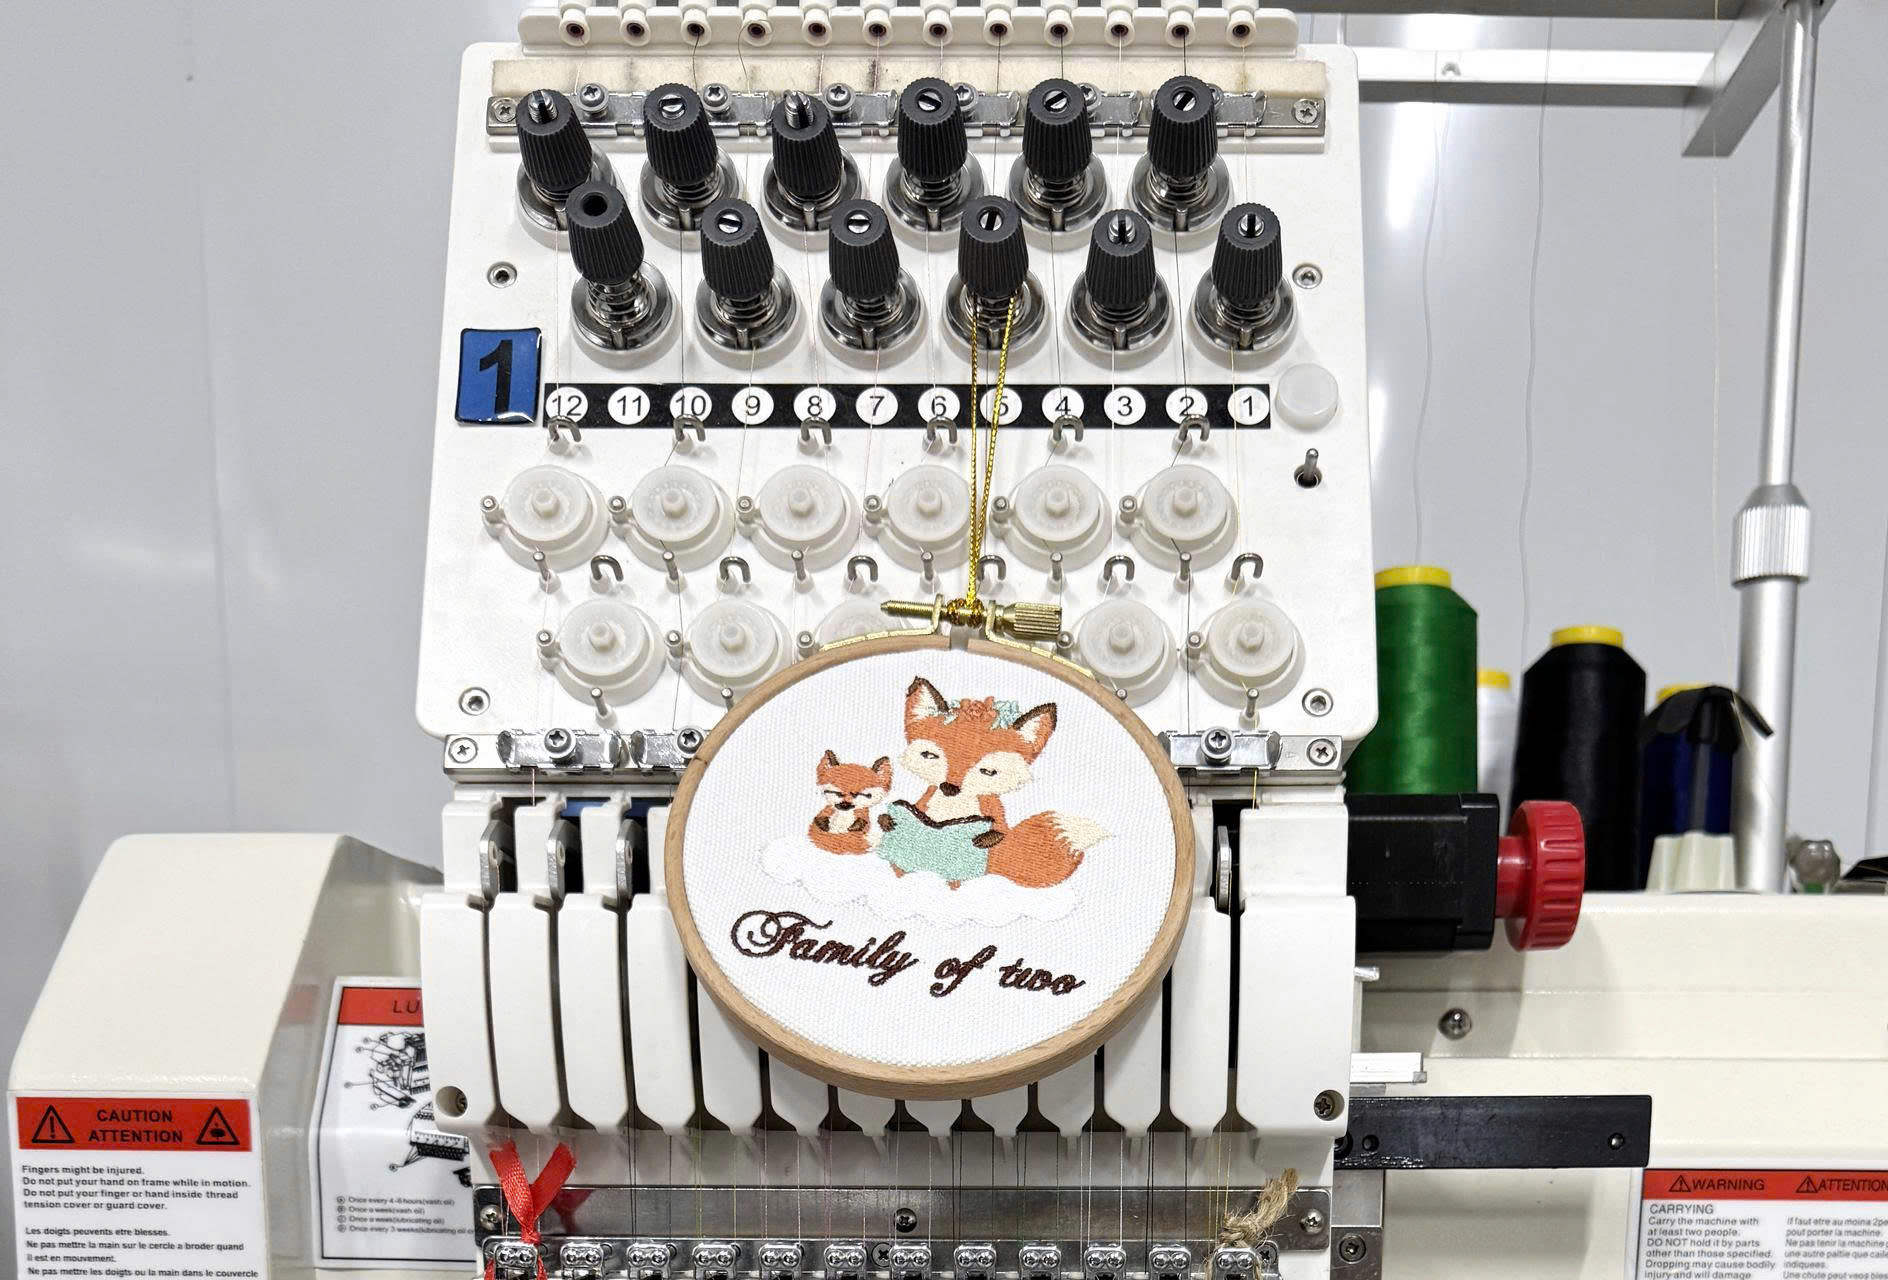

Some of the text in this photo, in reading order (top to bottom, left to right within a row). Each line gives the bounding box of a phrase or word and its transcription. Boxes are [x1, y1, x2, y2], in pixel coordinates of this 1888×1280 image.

[479, 339, 513, 414] 1
[552, 395, 582, 416] 12
[617, 395, 642, 416] 11
[676, 395, 706, 416] 10
[746, 395, 760, 416] 9
[807, 395, 823, 417] 8
[870, 395, 884, 416] 7
[931, 396, 946, 417] 6
[1055, 396, 1071, 416] 4
[1117, 396, 1132, 416] 3
[1179, 396, 1195, 416] 2
[1244, 396, 1254, 416] 1
[731, 910, 1086, 998] Family of two
[96, 1109, 172, 1122] CAUTION
[88, 1129, 183, 1143] ATTENTION
[22, 1165, 144, 1176] Fingers might be injured.
[23, 1177, 36, 1185] Do
[39, 1177, 55, 1185] not
[57, 1178, 73, 1186] put
[75, 1179, 97, 1187] your
[100, 1178, 124, 1186] hand
[142, 1179, 170, 1187] frame
[172, 1179, 198, 1187] while
[213, 1180, 251, 1188] motion.
[1693, 1179, 1765, 1191] WARNING
[23, 1189, 37, 1197] Do
[40, 1189, 55, 1197] not
[58, 1190, 74, 1198] put
[76, 1190, 98, 1199] your
[101, 1190, 129, 1199] finger
[172, 1190, 202, 1198] inside
[206, 1191, 238, 1199] thread
[24, 1201, 61, 1209] tension
[106, 1202, 134, 1211] guard
[1650, 1204, 1714, 1215] CARRYING
[1648, 1217, 1675, 1226] Carry
[1678, 1217, 1693, 1225] the
[1696, 1217, 1737, 1225] machine
[1660, 1228, 1683, 1236] least
[1705, 1228, 1740, 1237] people.
[40, 1242, 56, 1250] pas
[58, 1241, 86, 1249] mettre
[88, 1241, 97, 1249] la
[99, 1241, 120, 1249] main
[148, 1242, 175, 1250] cercle
[185, 1242, 214, 1250] broder
[217, 1243, 244, 1252] quand
[1647, 1239, 1662, 1247] DO
[1665, 1239, 1688, 1247] NOT
[1690, 1239, 1711, 1247] hold
[1722, 1239, 1733, 1248] by
[1735, 1240, 1760, 1248] parts
[1727, 1250, 1773, 1259] specified.
[1645, 1260, 1690, 1270] Dropping
[1692, 1262, 1712, 1270] may
[1746, 1260, 1776, 1270] bodily
[1674, 1271, 1692, 1279] and
[1694, 1271, 1710, 1279] will
[1712, 1271, 1752, 1280] damage
